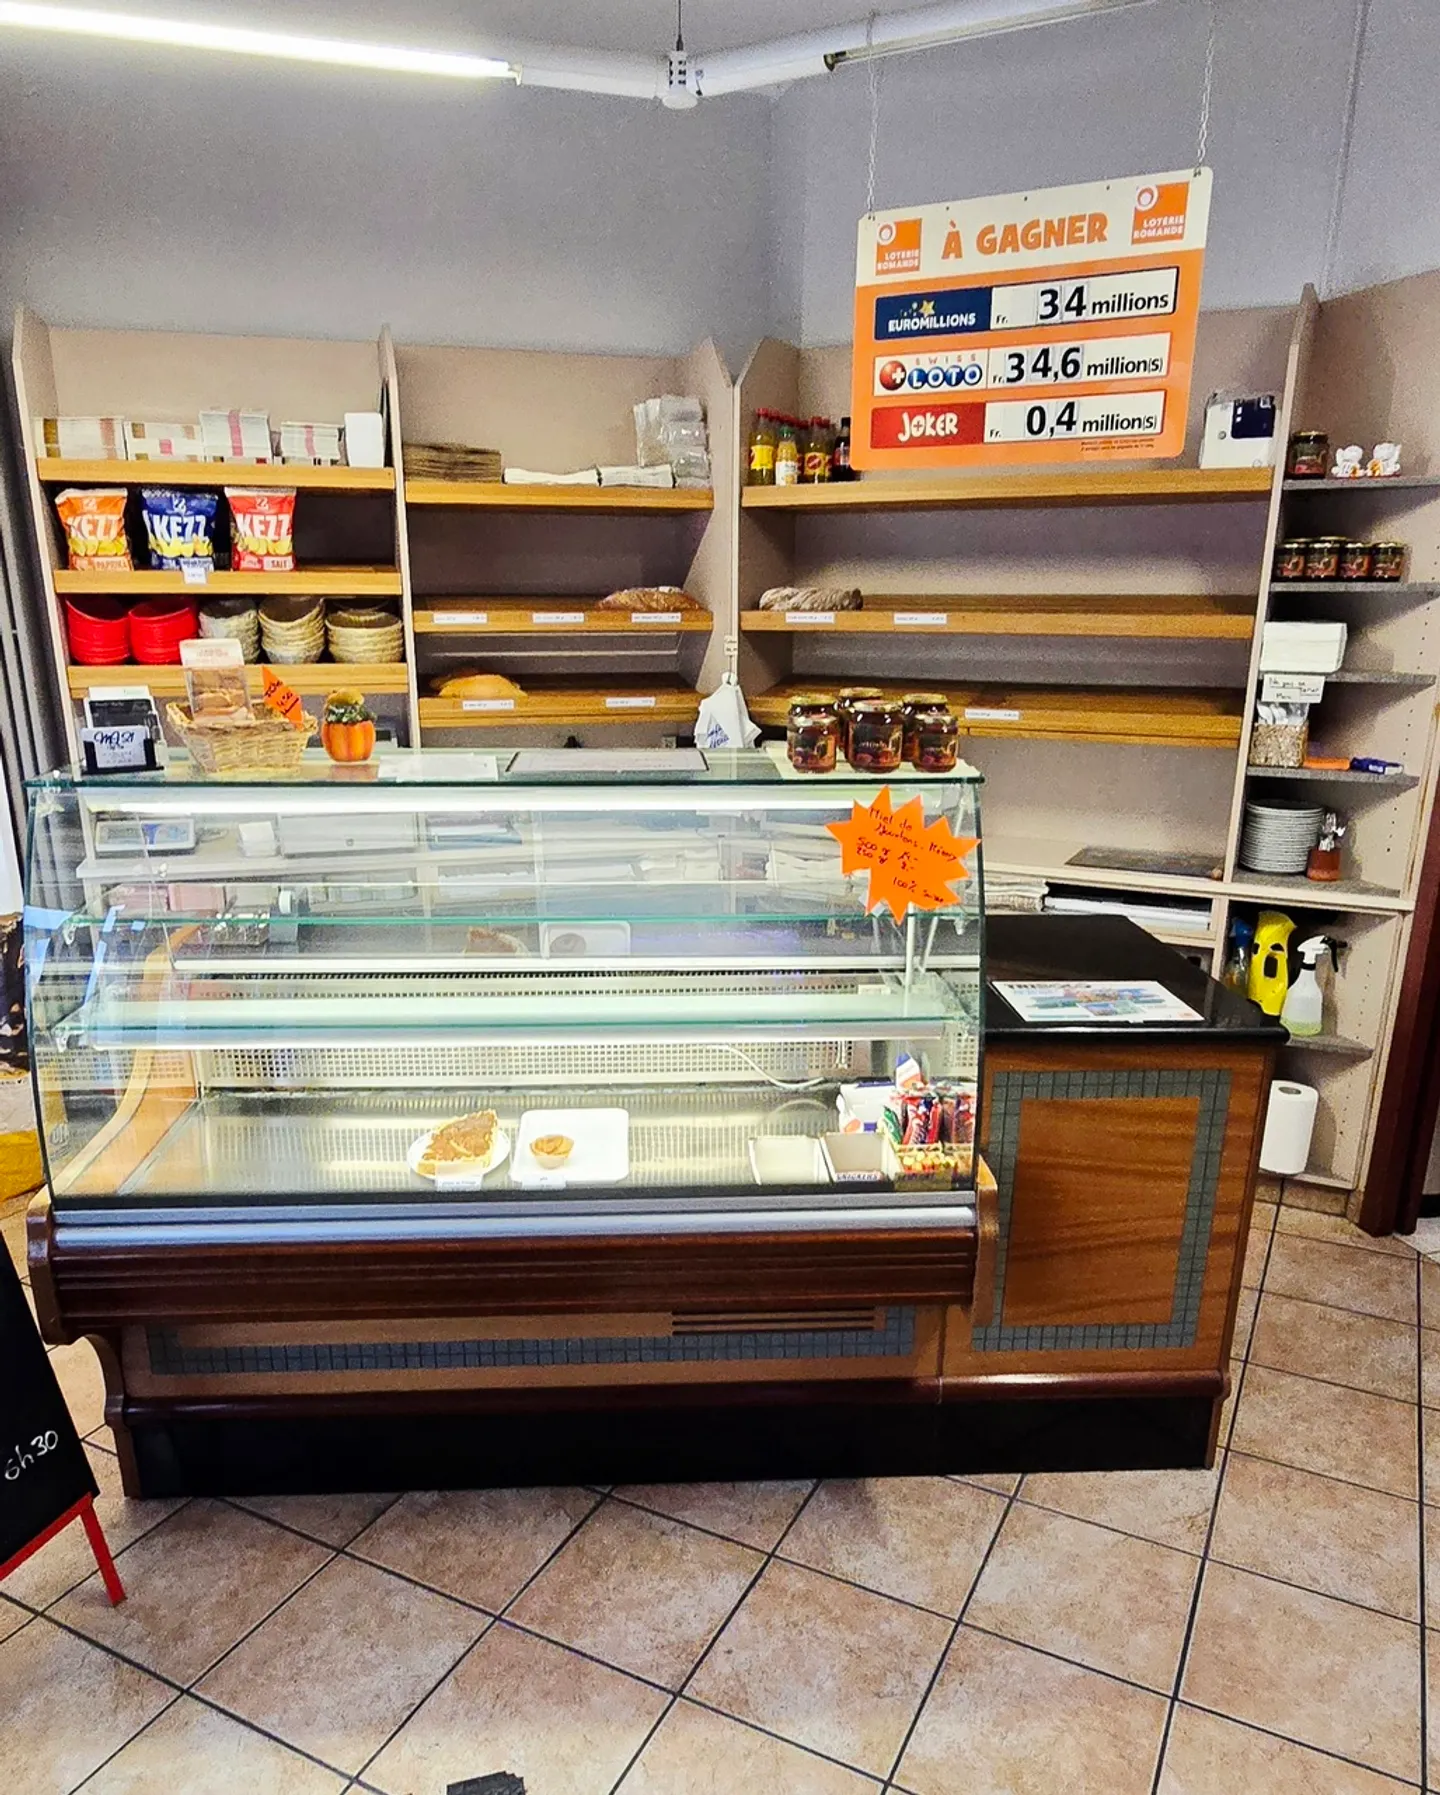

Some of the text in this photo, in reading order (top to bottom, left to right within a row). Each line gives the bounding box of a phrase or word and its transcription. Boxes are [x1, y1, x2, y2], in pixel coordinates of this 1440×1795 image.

[1133, 224, 1184, 239] ROMANDE
[1143, 214, 1185, 228] LOTERIE
[941, 212, 1109, 259] À GAGNER
[876, 259, 919, 271] ROMANDE
[884, 249, 919, 260] LOTERIE
[995, 285, 1169, 325] Fr. 34 millions
[887, 312, 976, 333] EUROMILLIONS
[908, 367, 982, 388] LOTO
[1006, 347, 1081, 383] 34,6
[1086, 357, 1164, 377] million(s)
[898, 412, 959, 442] JOKER
[989, 401, 1157, 440] Fr. 0,4 million(s)
[153, 514, 208, 542] KEZZ
[235, 513, 292, 541] KEZZ
